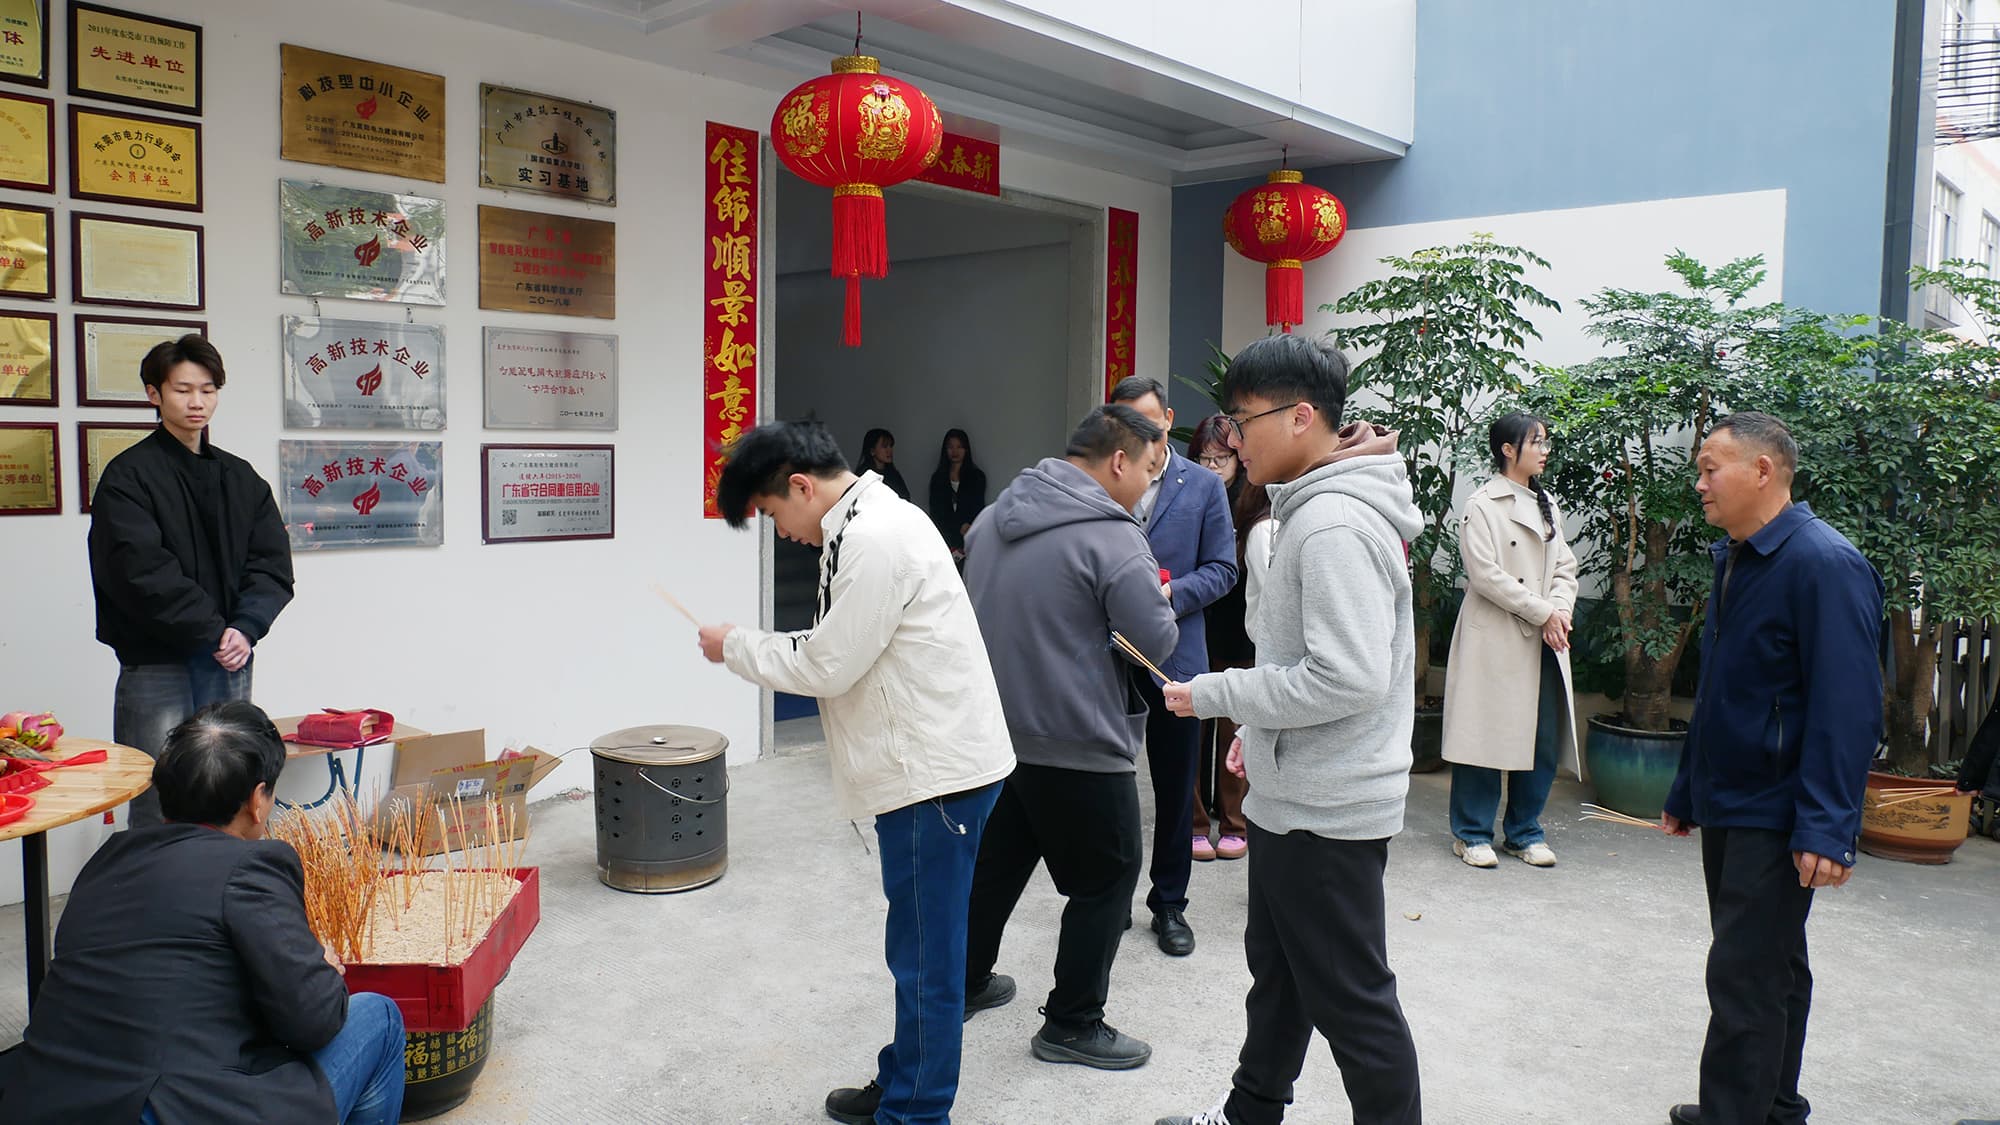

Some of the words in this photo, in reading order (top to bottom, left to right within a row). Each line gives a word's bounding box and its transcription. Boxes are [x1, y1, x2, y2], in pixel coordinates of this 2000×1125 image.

[2, 31, 24, 45] 体
[91, 46, 185, 74] 先进单位
[297, 74, 431, 123] 科技型中小企业
[783, 93, 816, 137] 福
[94, 130, 182, 163] 东莞市电力行业协会
[109, 169, 170, 187] 会员单位
[518, 167, 589, 193] 实习基地
[303, 207, 428, 254] 高新技术企业
[2, 365, 30, 377] 单位
[305, 337, 430, 379] 高新技术企业
[0, 473, 42, 485] 秀单位
[301, 457, 428, 497] 高新技术企业
[502, 482, 600, 498] 广东省守合同重信用企业
[457, 1024, 478, 1053] 福
[405, 1041, 429, 1067] 福
